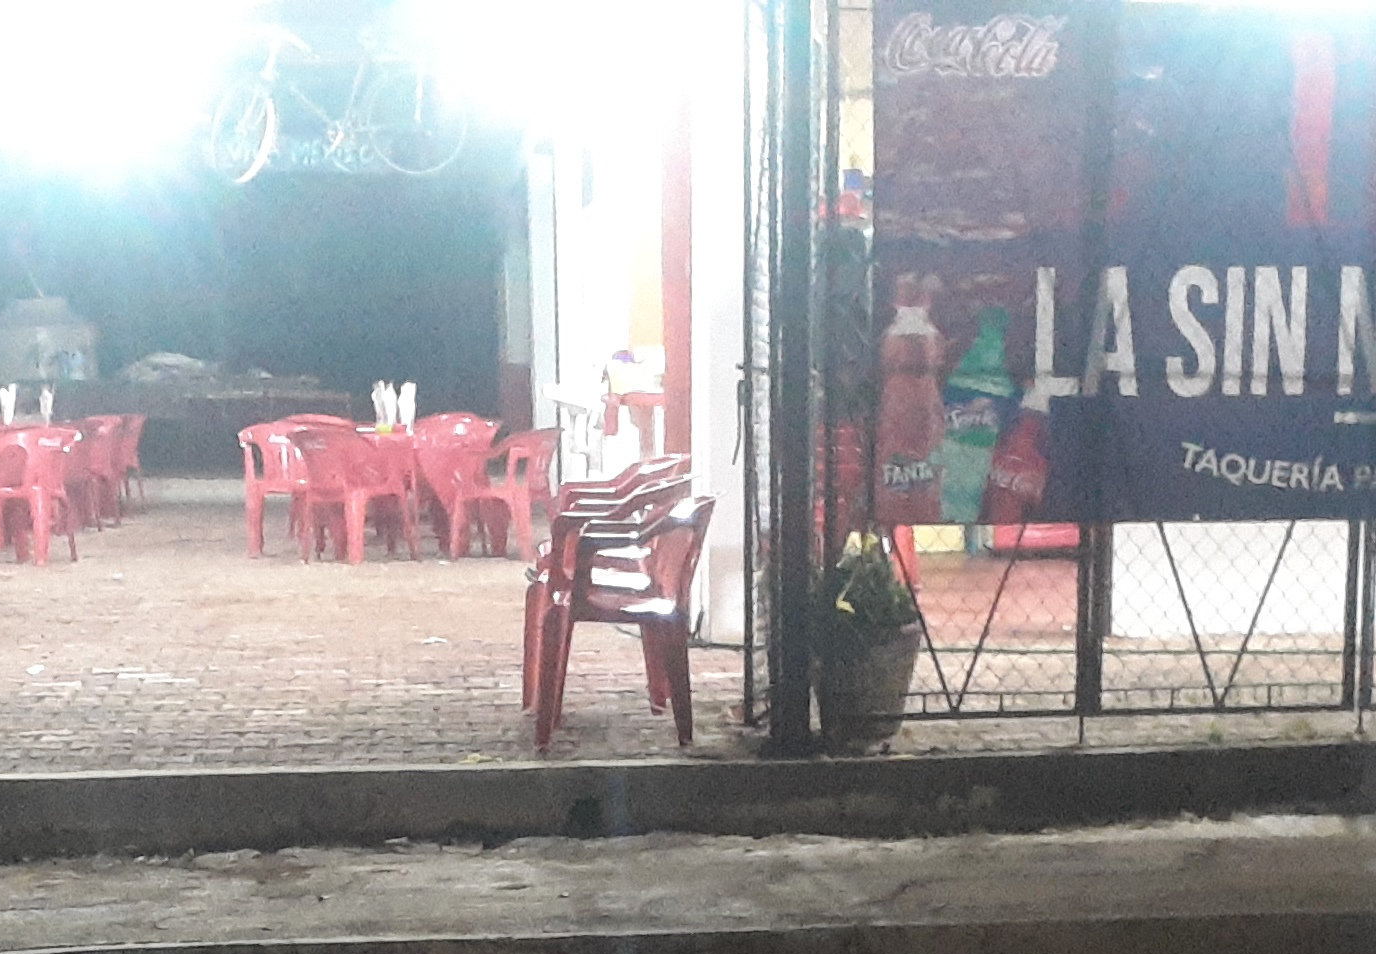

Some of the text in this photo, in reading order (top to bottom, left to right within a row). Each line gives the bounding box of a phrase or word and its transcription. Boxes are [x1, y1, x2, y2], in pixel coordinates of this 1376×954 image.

[885, 12, 1068, 77] Coca-Cola
[1034, 264, 1139, 397] LA
[1165, 263, 1308, 398] SIN
[1181, 441, 1345, 491] TAQUERÍA
